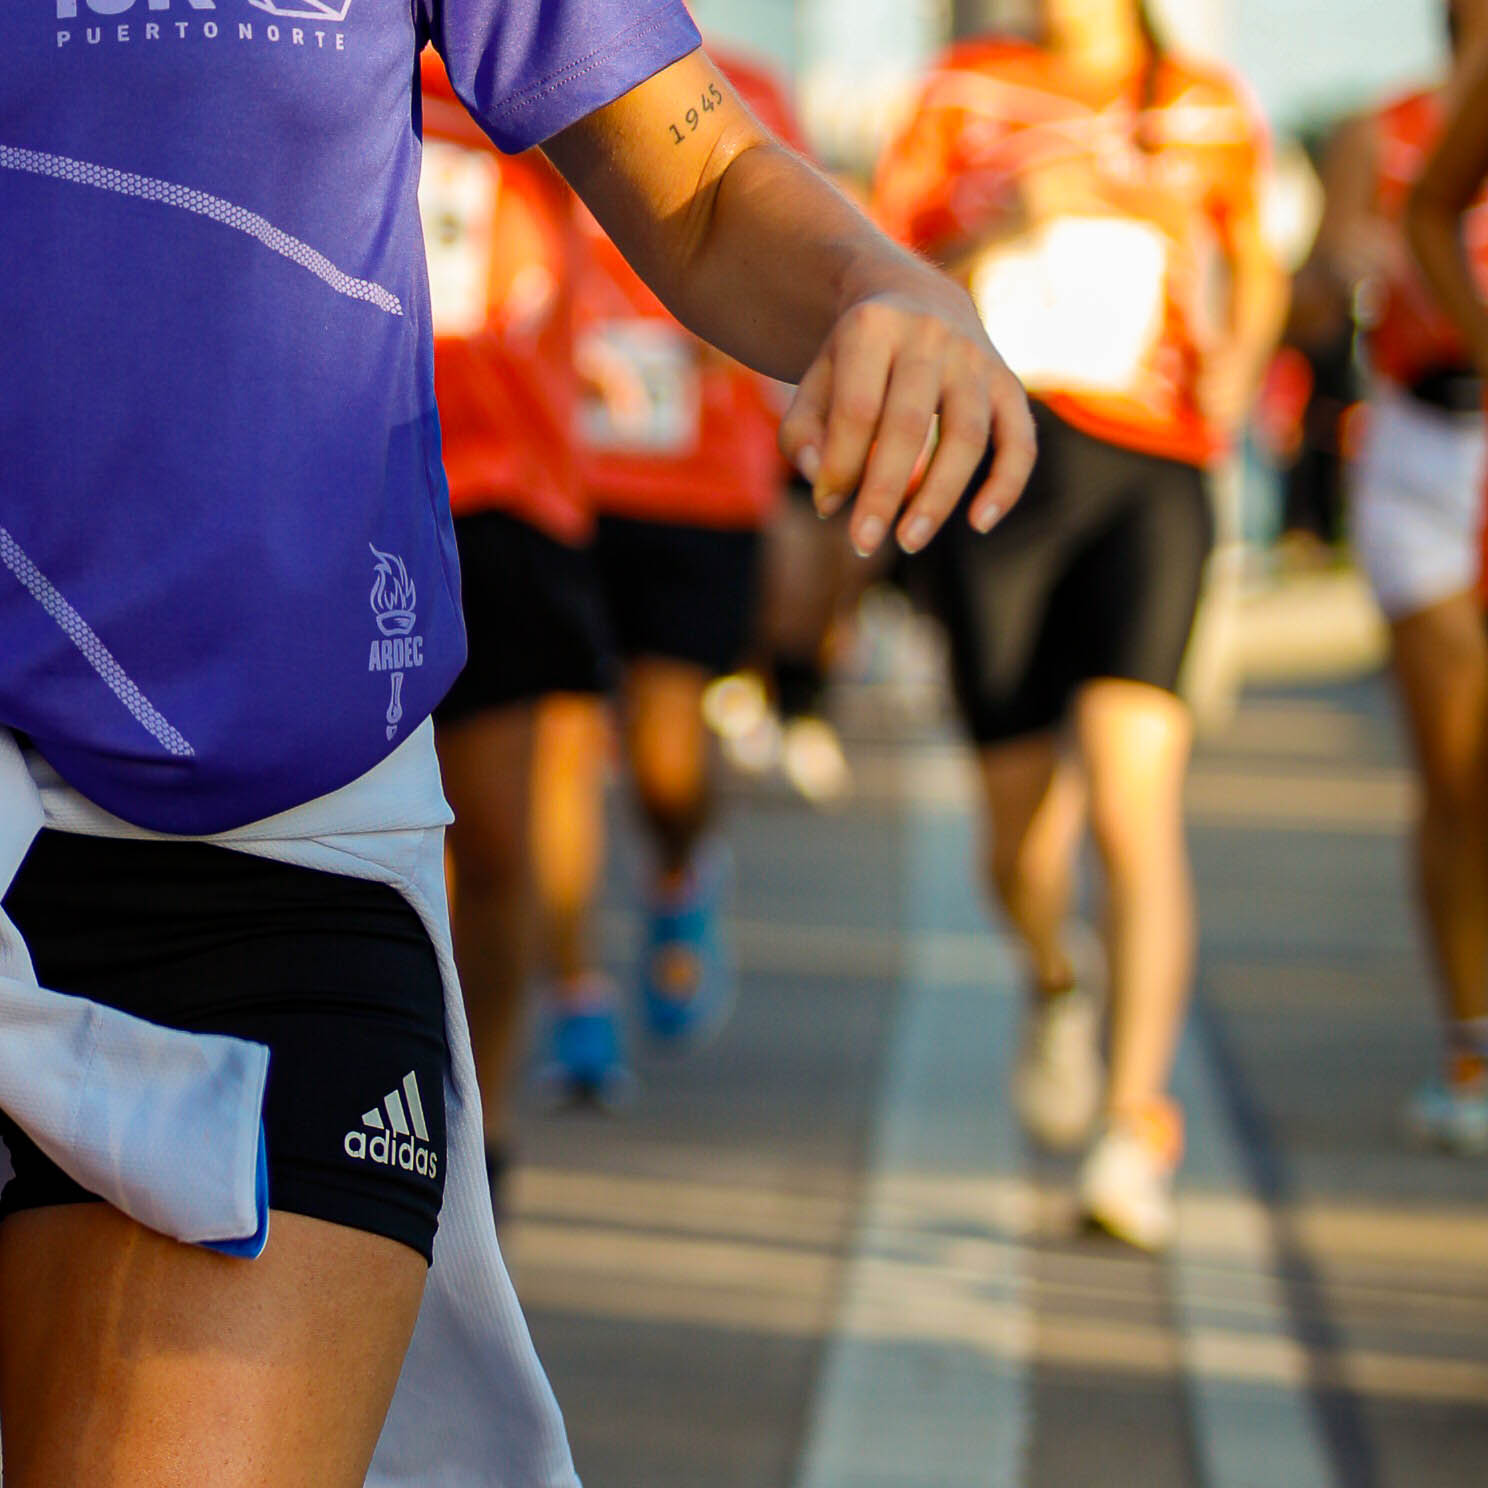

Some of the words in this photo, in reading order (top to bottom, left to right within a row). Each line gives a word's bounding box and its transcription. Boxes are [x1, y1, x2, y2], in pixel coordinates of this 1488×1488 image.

[56, 21, 219, 48] PUERTO
[238, 22, 346, 50] NORTE
[668, 82, 723, 146] 1945
[368, 635, 424, 672] ARDEC
[343, 1128, 438, 1179] adidas
